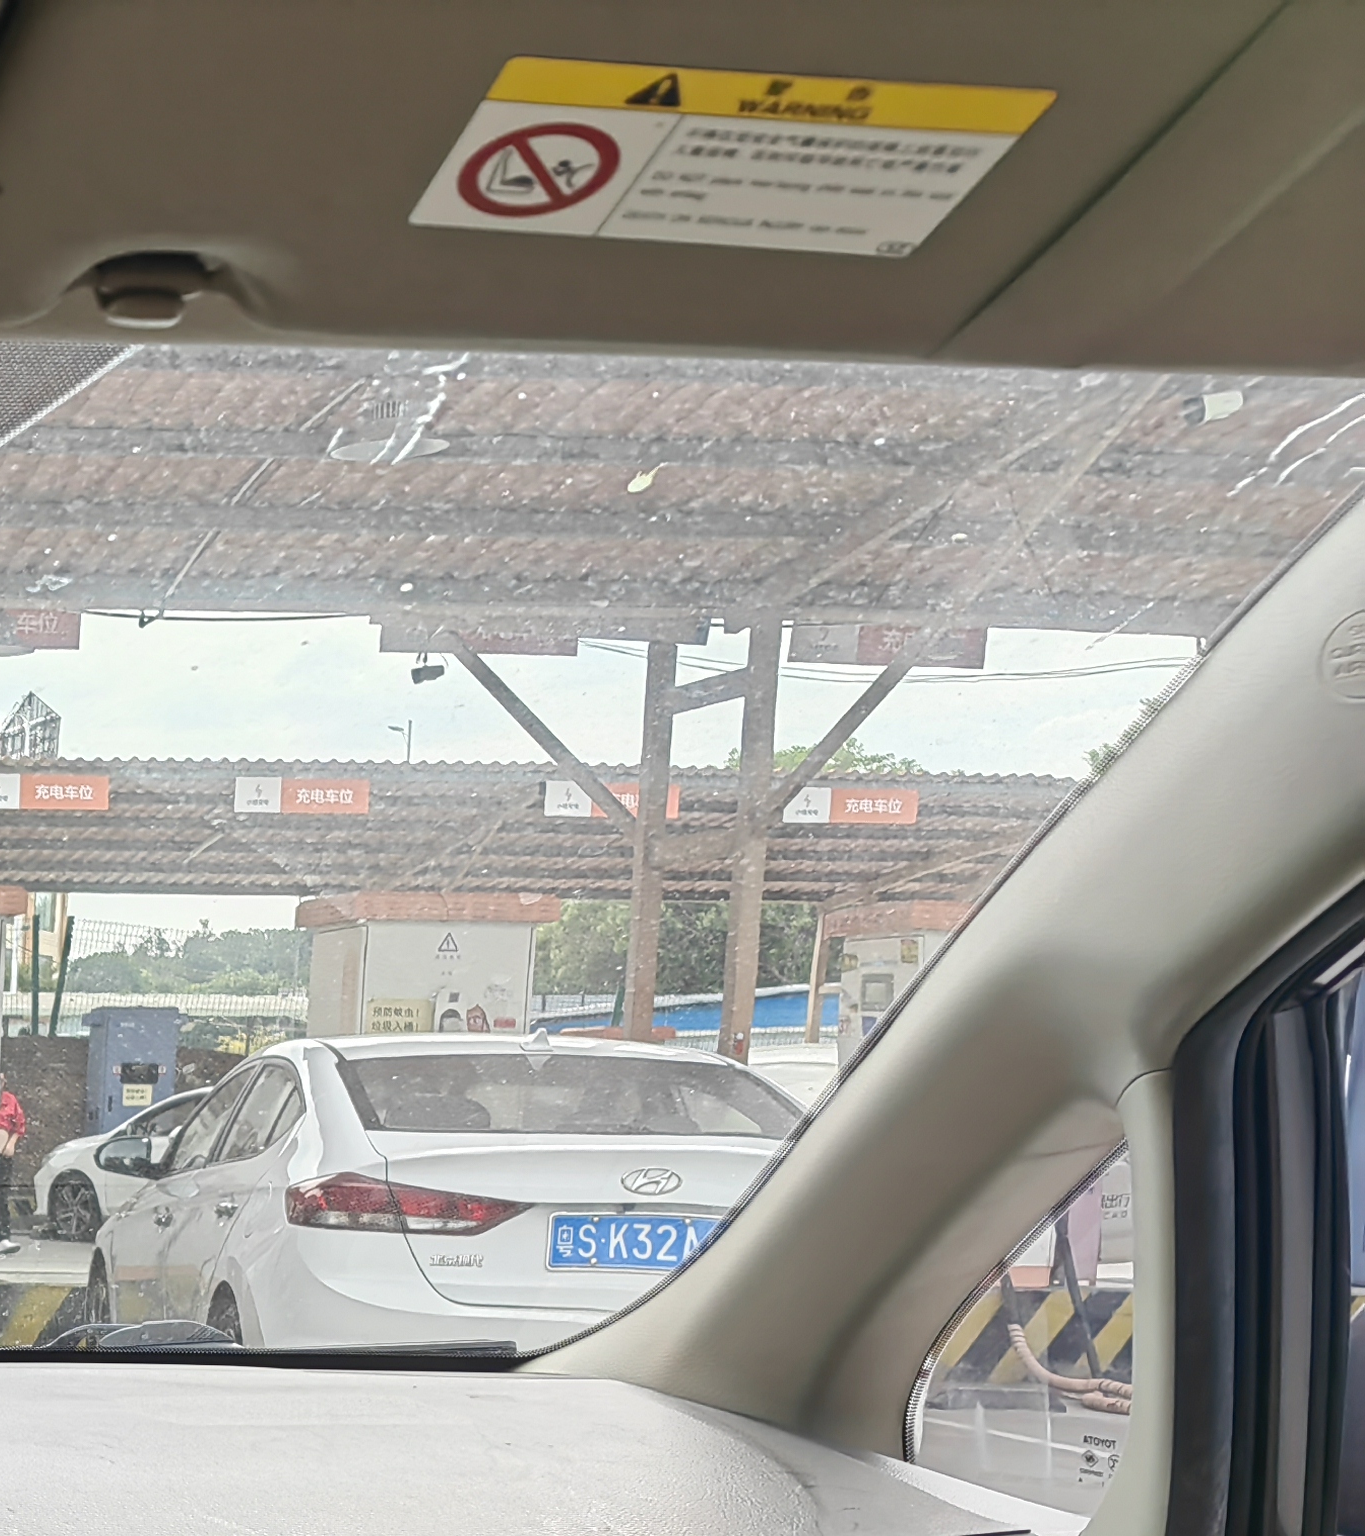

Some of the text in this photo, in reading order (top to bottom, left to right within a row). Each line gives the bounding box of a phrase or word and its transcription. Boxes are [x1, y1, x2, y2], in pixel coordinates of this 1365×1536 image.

[34, 784, 94, 800] 充电车位
[295, 788, 354, 804] 充电车位
[844, 798, 903, 814] 充电车位
